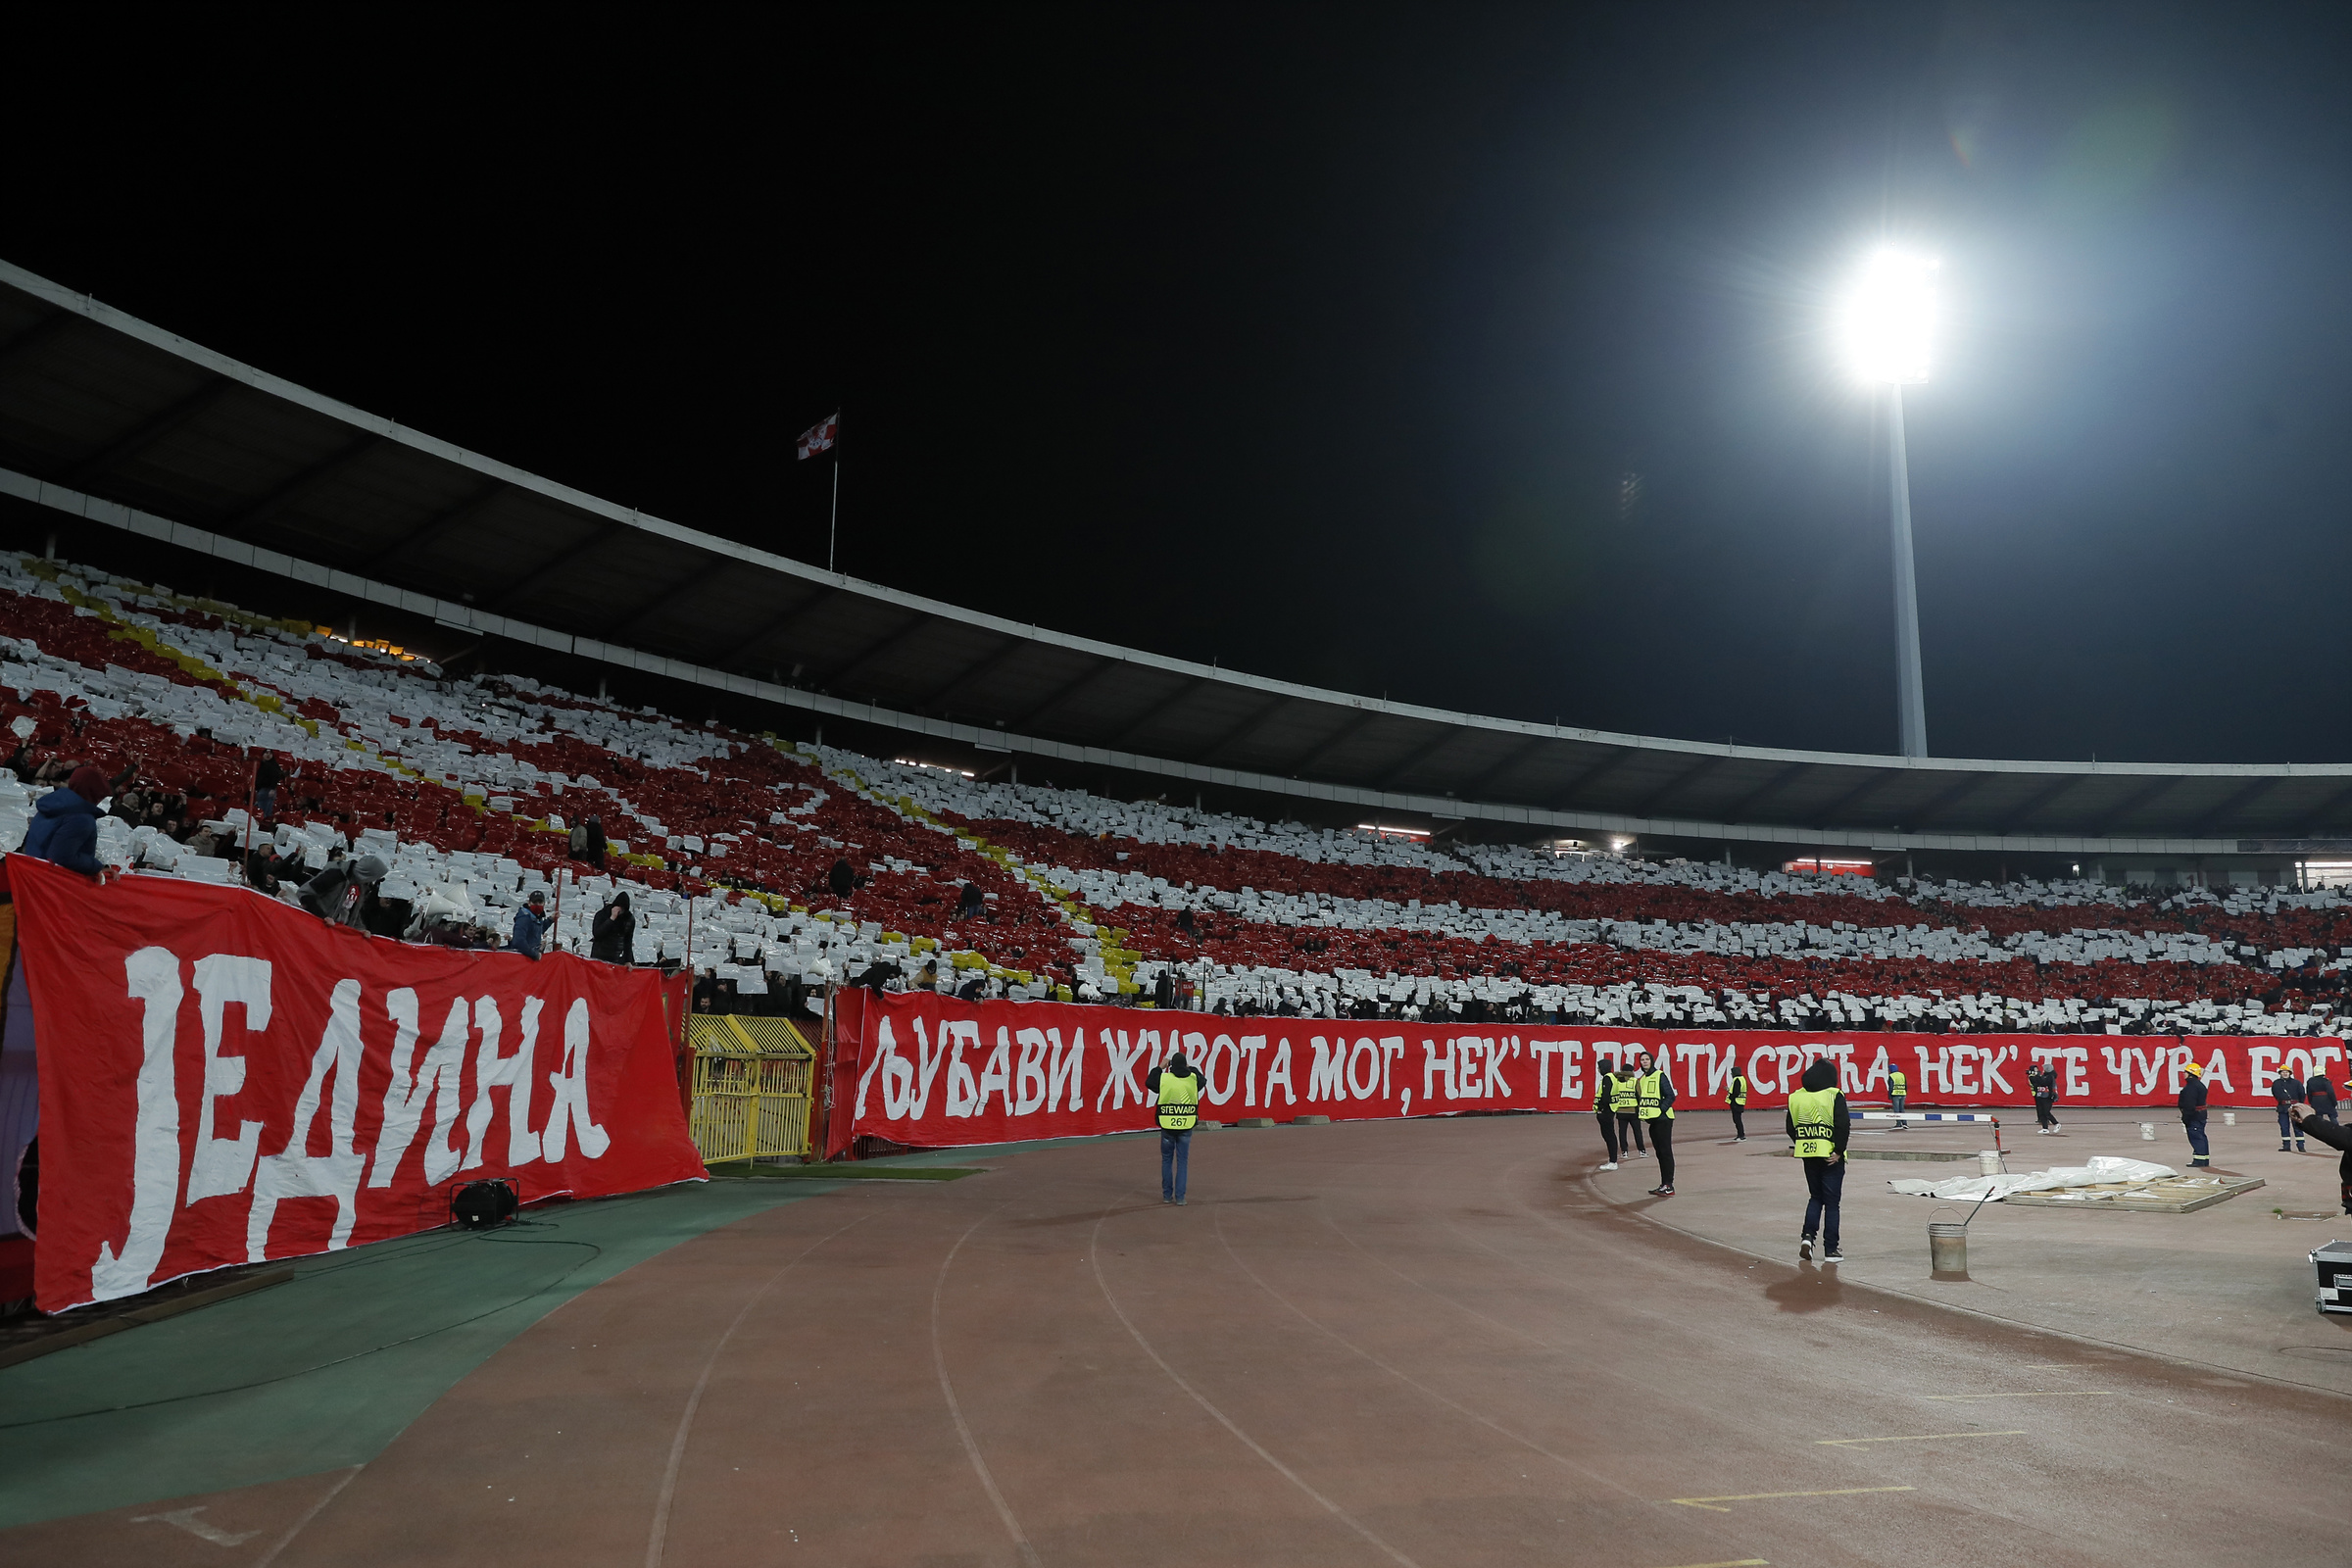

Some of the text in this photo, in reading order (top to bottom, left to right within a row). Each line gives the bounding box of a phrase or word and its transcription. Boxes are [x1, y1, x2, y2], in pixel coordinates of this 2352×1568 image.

[855, 1015, 1085, 1120] ЉУБАВИ
[1306, 1035, 1412, 1116] МОГ,
[1530, 1040, 1583, 1100] ТЕ
[2100, 1046, 2235, 1096] ЧУВА
[92, 946, 611, 1302] ЈЕДИНА
[1170, 1117, 1188, 1126] 267
[1795, 1126, 1834, 1139] EWARD
